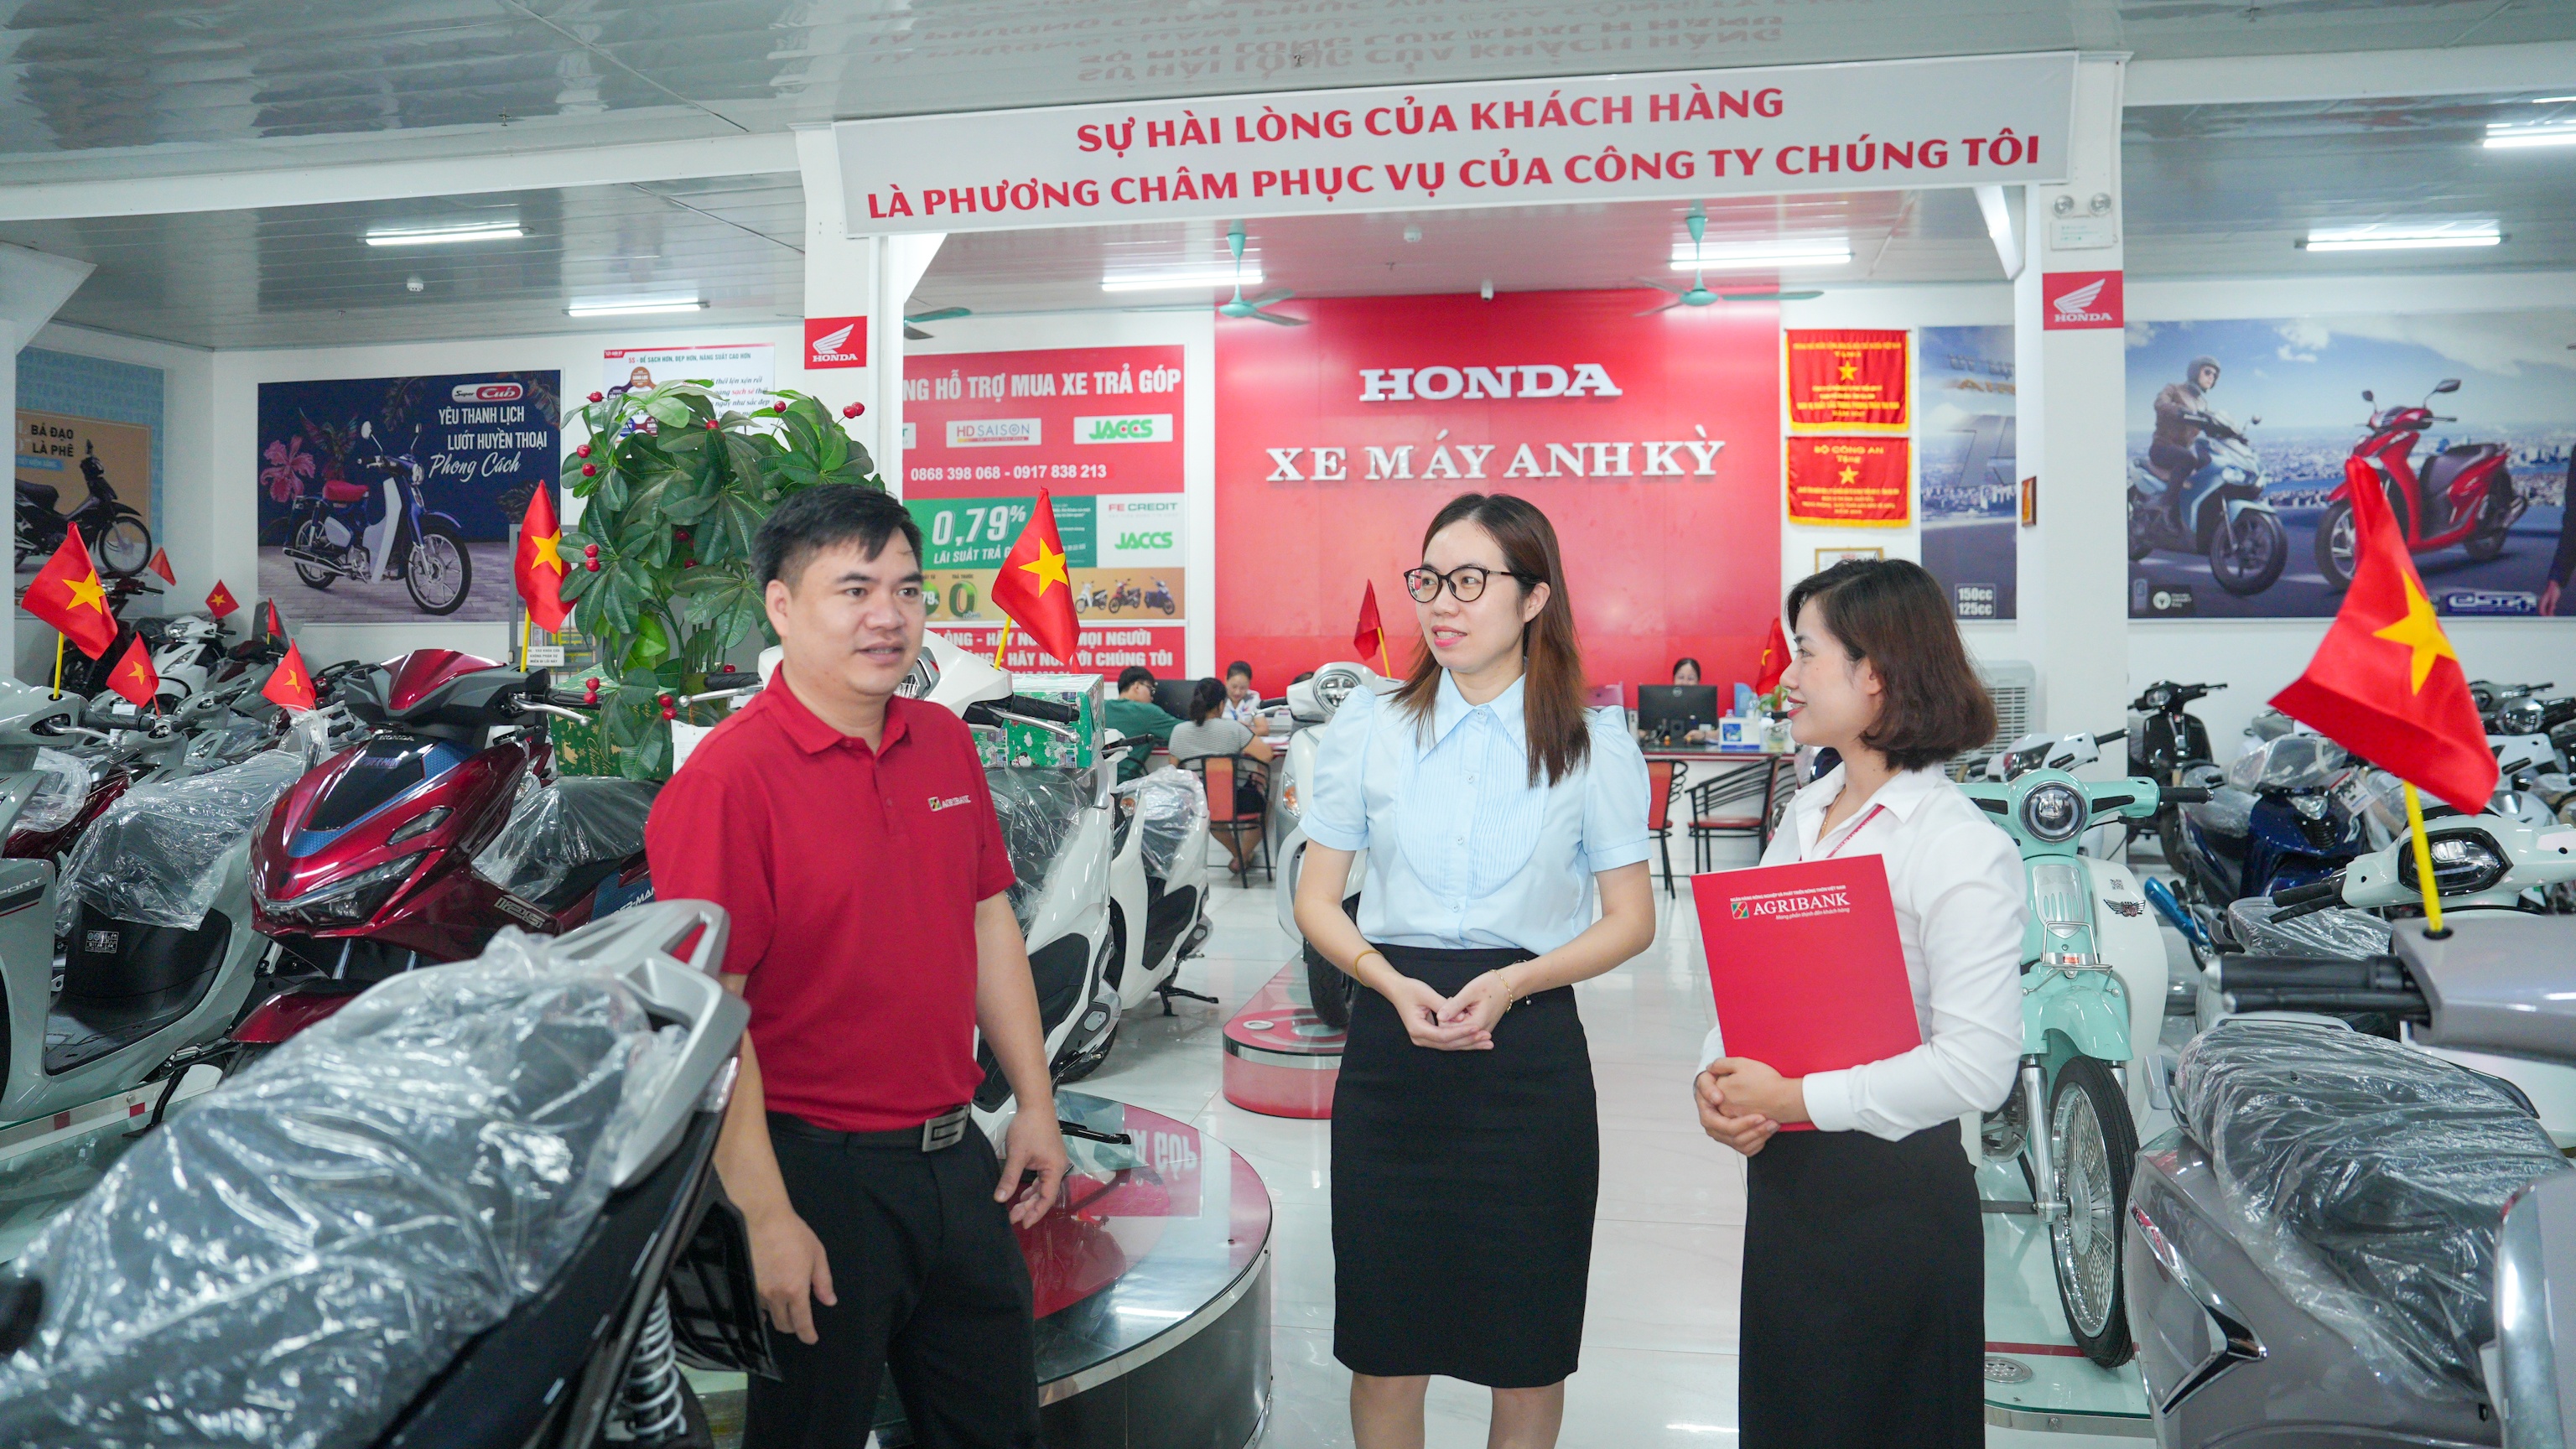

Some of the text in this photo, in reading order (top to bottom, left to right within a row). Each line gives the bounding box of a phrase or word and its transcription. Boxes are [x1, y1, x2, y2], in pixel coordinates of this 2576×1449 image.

[1078, 84, 1783, 158] SỰ HÀI LÒNG CỦA KHÁCH HÀNG
[869, 128, 2038, 218] LÀ PHƯƠNG CHÂM PHỤC VỤ CỦA CÔNG TY CHÚNG TÔI
[2054, 313, 2112, 322] HONDA
[813, 353, 858, 362] HONDA
[935, 369, 962, 400] HỖ
[967, 372, 1005, 402] TRỢ
[1010, 373, 1057, 397] MUA
[1061, 372, 1088, 396] XE
[1093, 363, 1133, 394] TRẢ
[1139, 364, 1182, 393] GÓP
[1358, 363, 1623, 402] HONDA
[481, 387, 516, 398] Cub
[439, 406, 524, 425] YÊU THANH LỊCH
[49, 427, 74, 441] ĐẠO
[448, 427, 547, 450] LƯỚT HUYỀN THOẠI
[957, 423, 1030, 437] HD SAISON
[1088, 419, 1153, 440] JACCS
[33, 440, 74, 457] LÀ PHÊ
[1266, 446, 1348, 482] XE
[1364, 428, 1495, 480] MÁY
[1867, 446, 1884, 454] AN
[428, 451, 521, 482] Phong Cách
[911, 467, 943, 480] 0868
[947, 467, 972, 480] 398
[975, 466, 1000, 480] 068
[1013, 465, 1047, 479] 0917
[1051, 465, 1077, 479] 838
[1080, 464, 1107, 478] 213
[1128, 502, 1178, 512] CREDIT
[932, 505, 1026, 547] 0,79%
[1114, 532, 1173, 550] JACCS
[934, 550, 949, 564] LÃI
[953, 547, 979, 563] SUẤT
[982, 544, 1001, 560] TRẢ
[1958, 587, 1993, 601] 150cc
[1958, 601, 1993, 615] 125cc
[937, 629, 974, 647] ÒNG
[1078, 631, 1102, 648] MỌI
[1107, 629, 1151, 646] NGƯỜI
[1008, 650, 1036, 666] HÃY
[1095, 649, 1145, 667] CHÚNG
[1150, 649, 1173, 666] TÔI
[0, 877, 42, 895] PORT
[494, 896, 545, 929] 125
[1753, 892, 1851, 916] AGRIBANK
